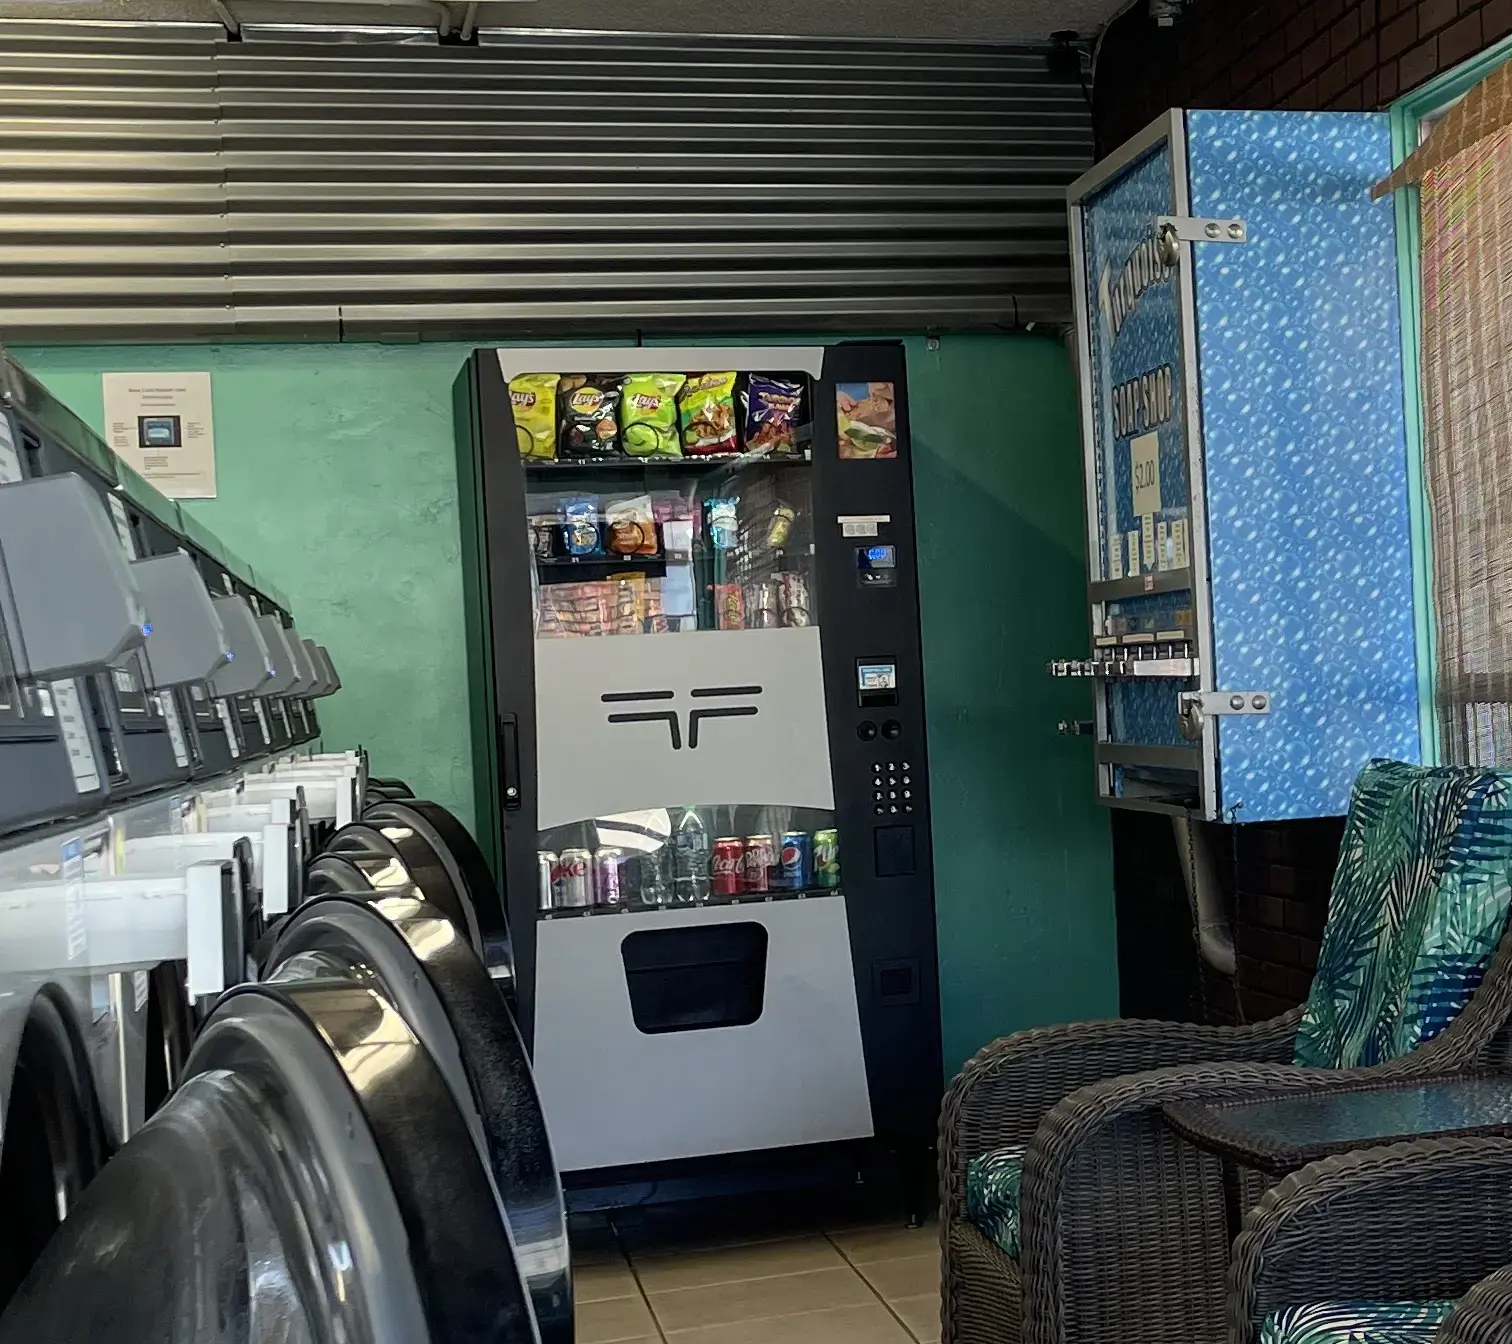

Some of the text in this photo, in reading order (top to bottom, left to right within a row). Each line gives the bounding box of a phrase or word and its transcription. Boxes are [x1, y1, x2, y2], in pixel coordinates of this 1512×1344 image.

[1098, 227, 1171, 351] Turquois
[1112, 363, 1172, 440] SOAP SHOP
[1135, 459, 1155, 492] $2.00
